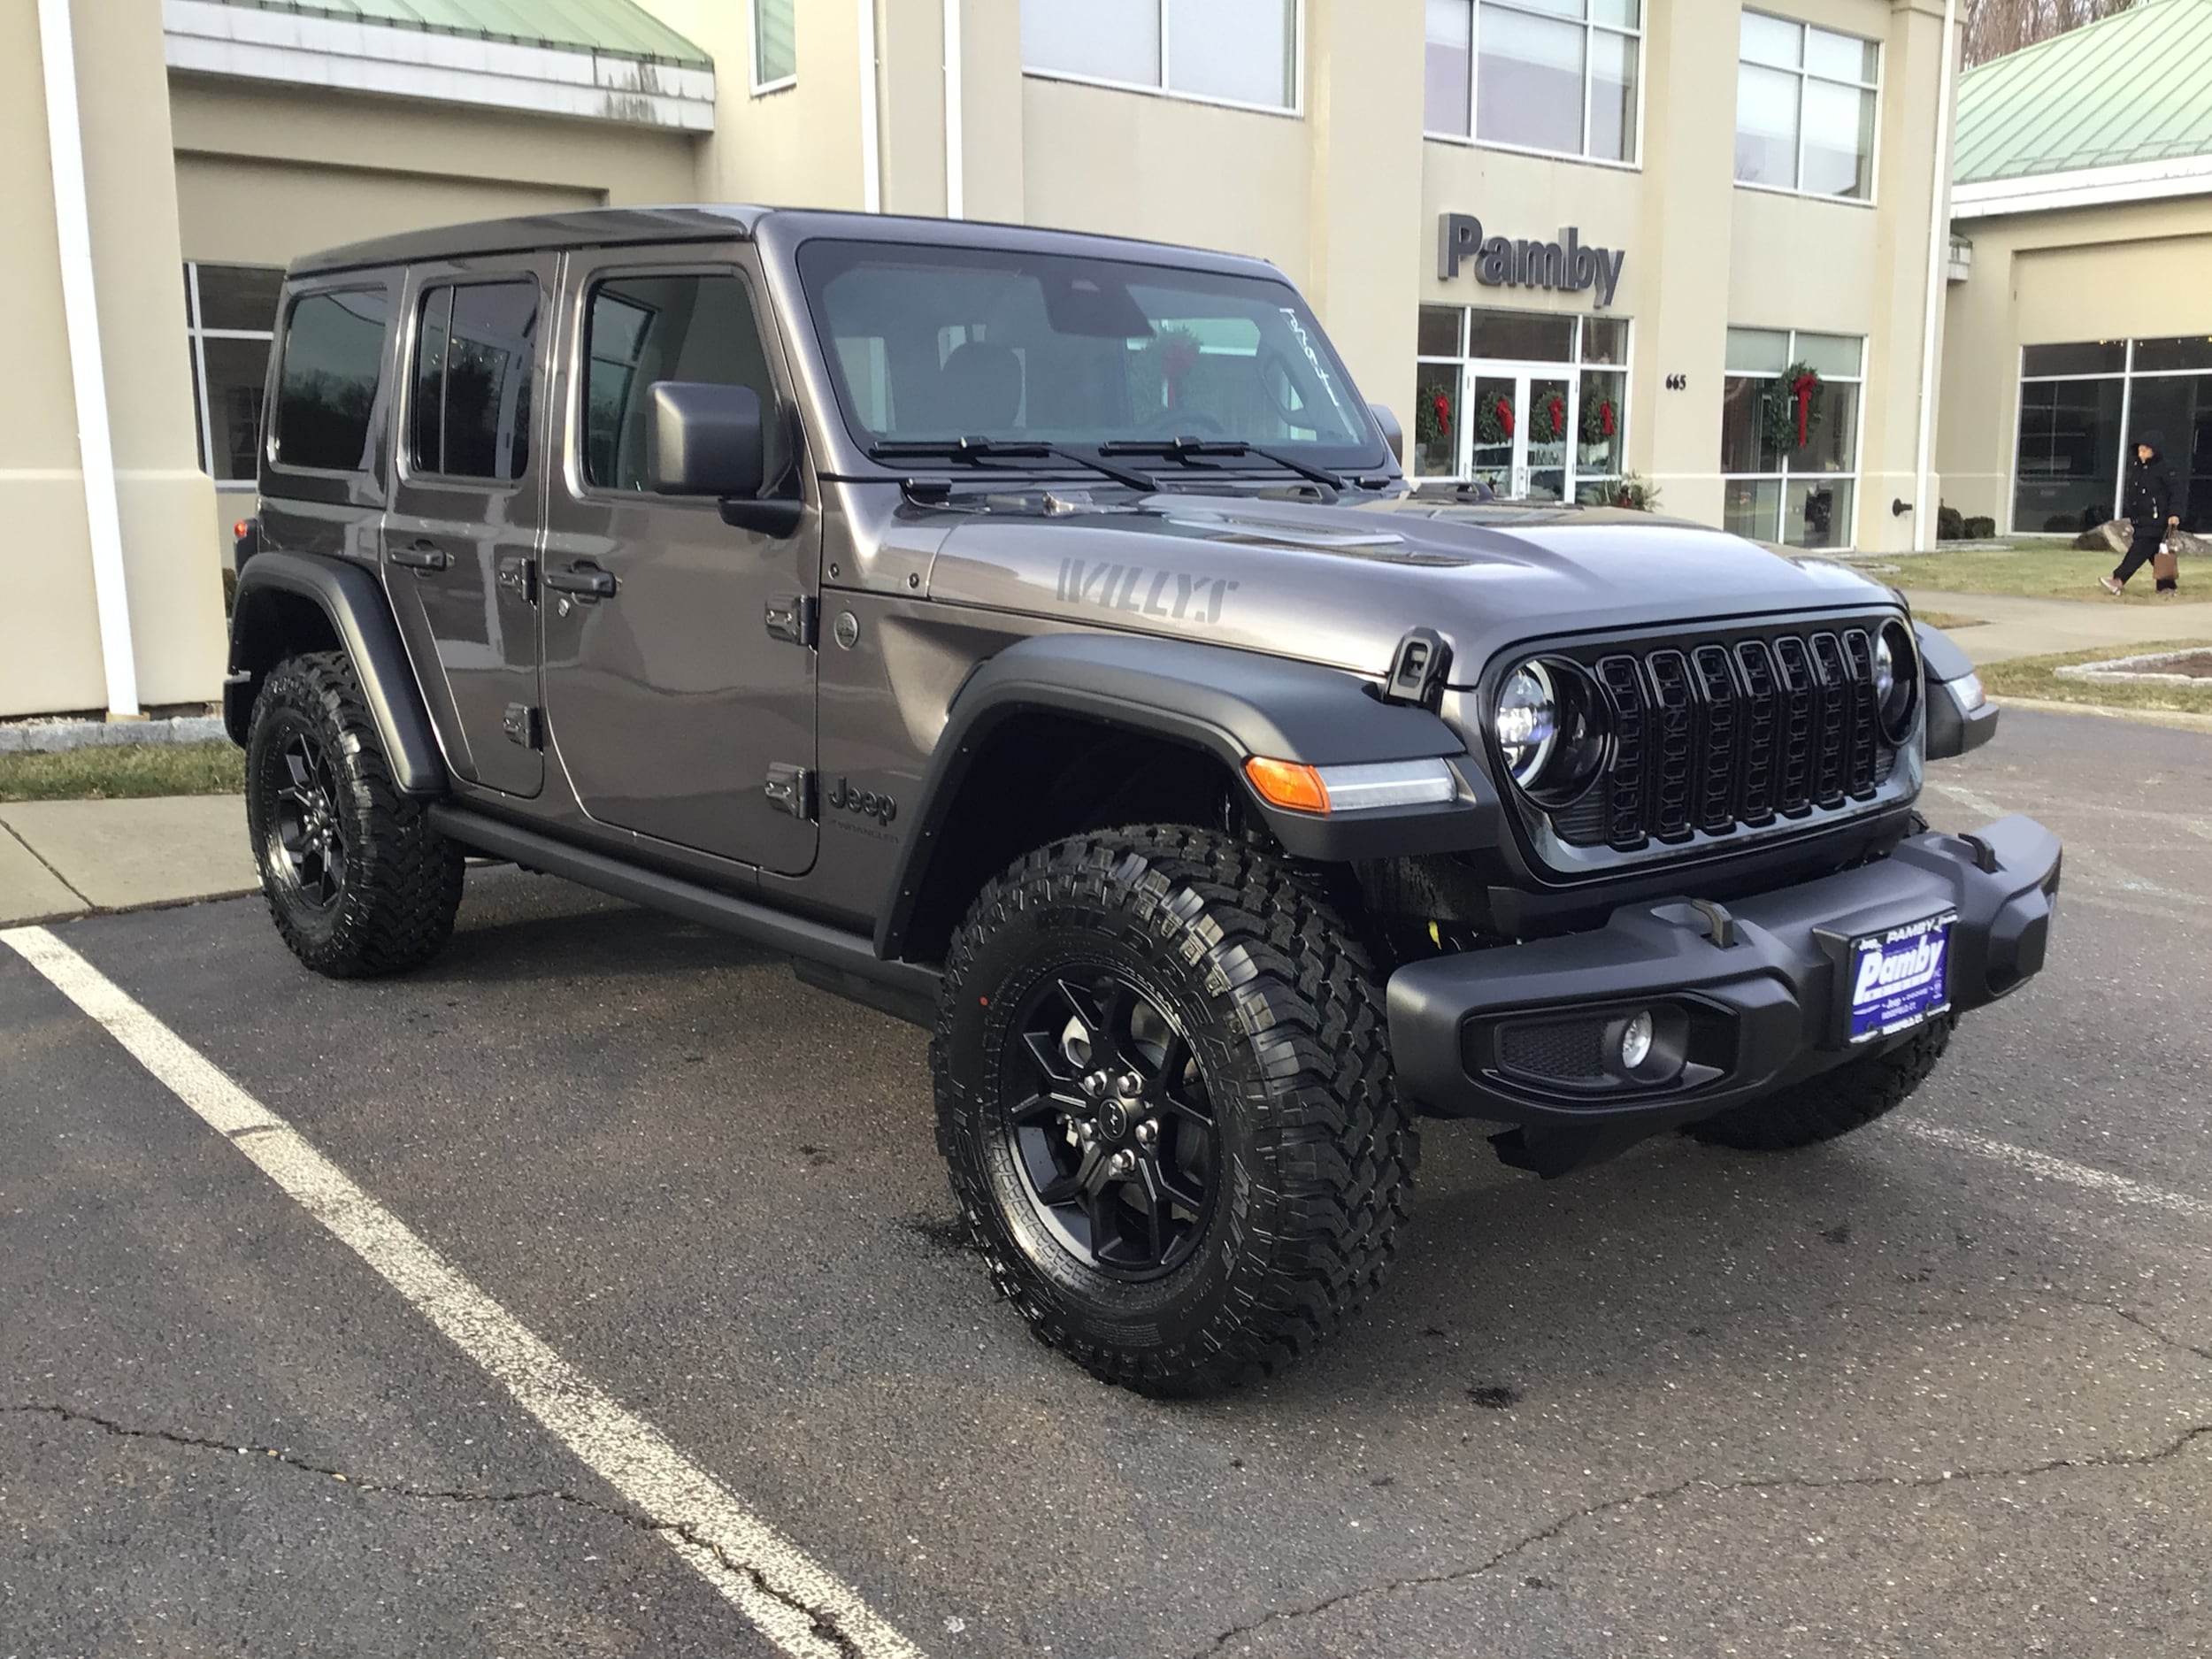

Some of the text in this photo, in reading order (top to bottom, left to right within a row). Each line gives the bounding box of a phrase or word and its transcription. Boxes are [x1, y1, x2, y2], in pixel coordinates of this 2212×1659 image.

[1438, 212, 1625, 308] Pamby
[1665, 373, 1686, 391] 665
[1056, 557, 1240, 624] WILLYS
[828, 777, 896, 827] Jeep
[1886, 918, 1936, 944] PAMBY
[1852, 933, 1946, 1006] Pamby
